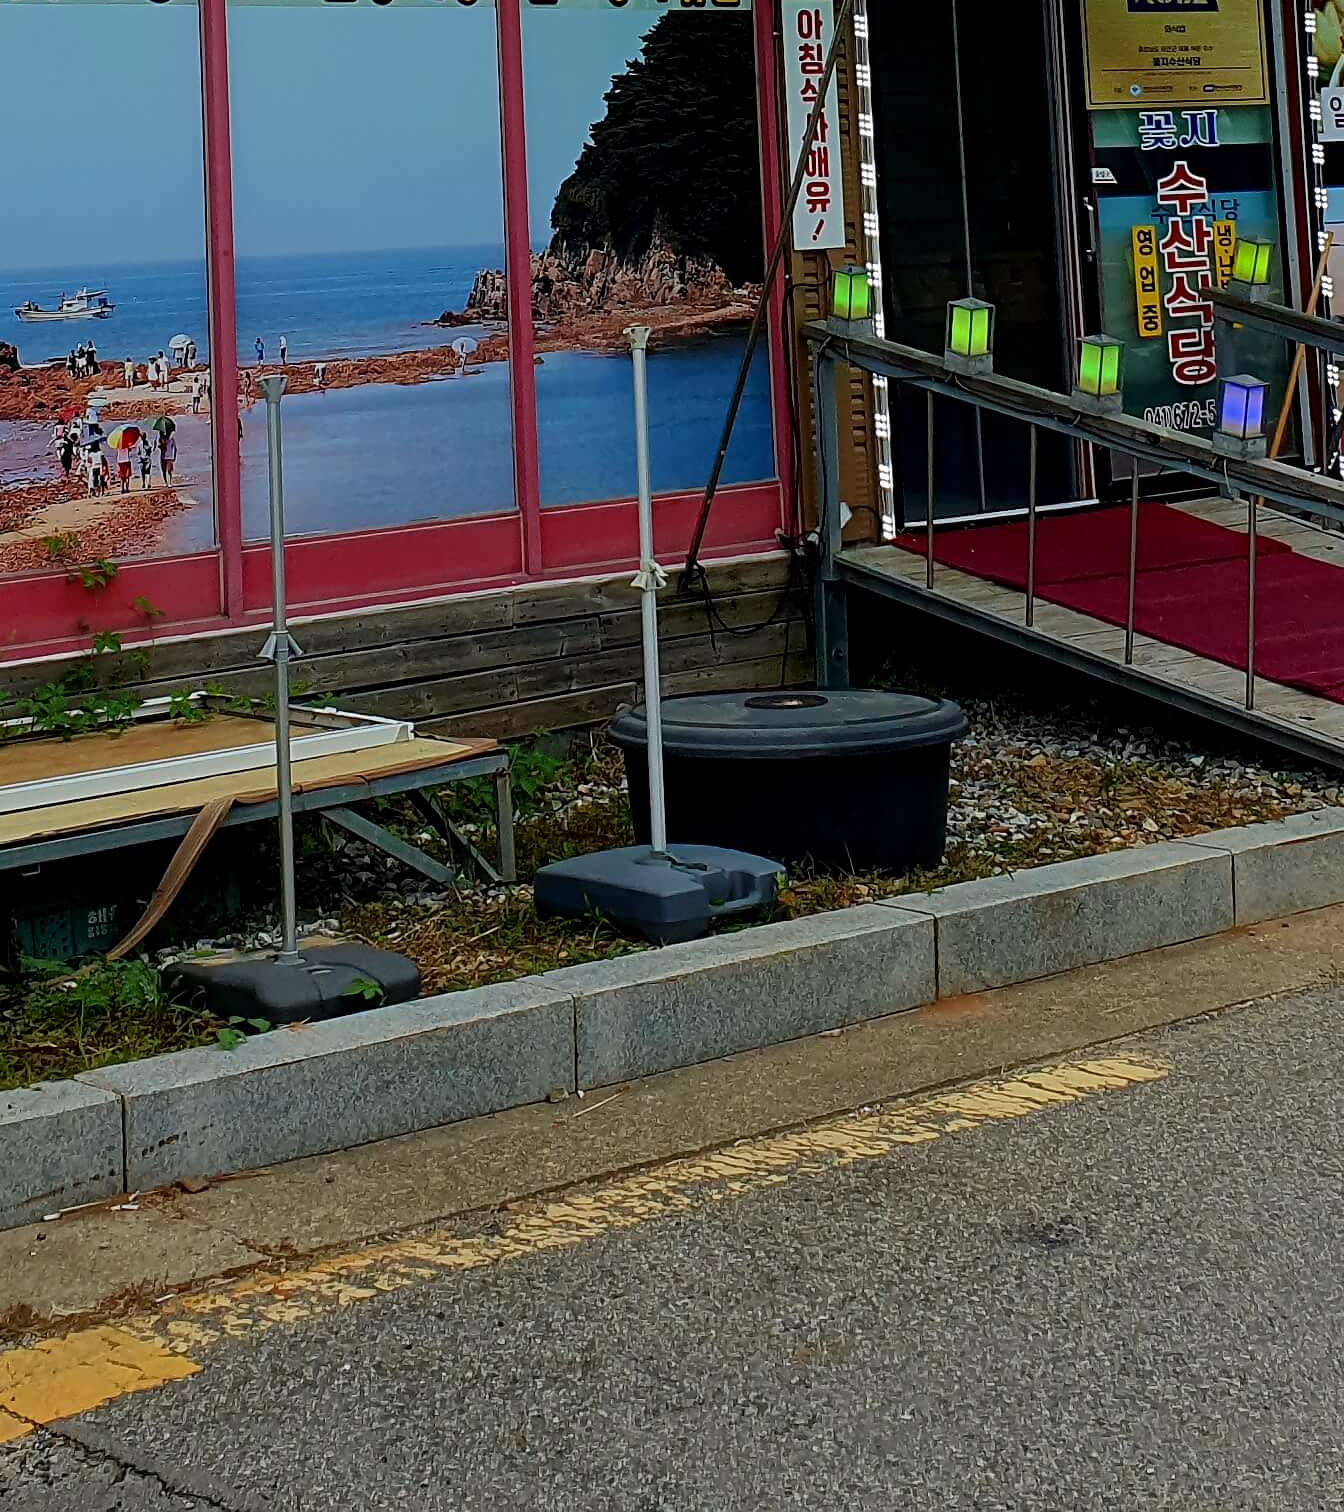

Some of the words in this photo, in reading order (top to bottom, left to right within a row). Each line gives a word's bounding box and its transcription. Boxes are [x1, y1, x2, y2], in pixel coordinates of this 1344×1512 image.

[1138, 110, 1220, 149] 꽃지
[1137, 230, 1160, 332] 영업중
[1157, 160, 1217, 385] 수산식당
